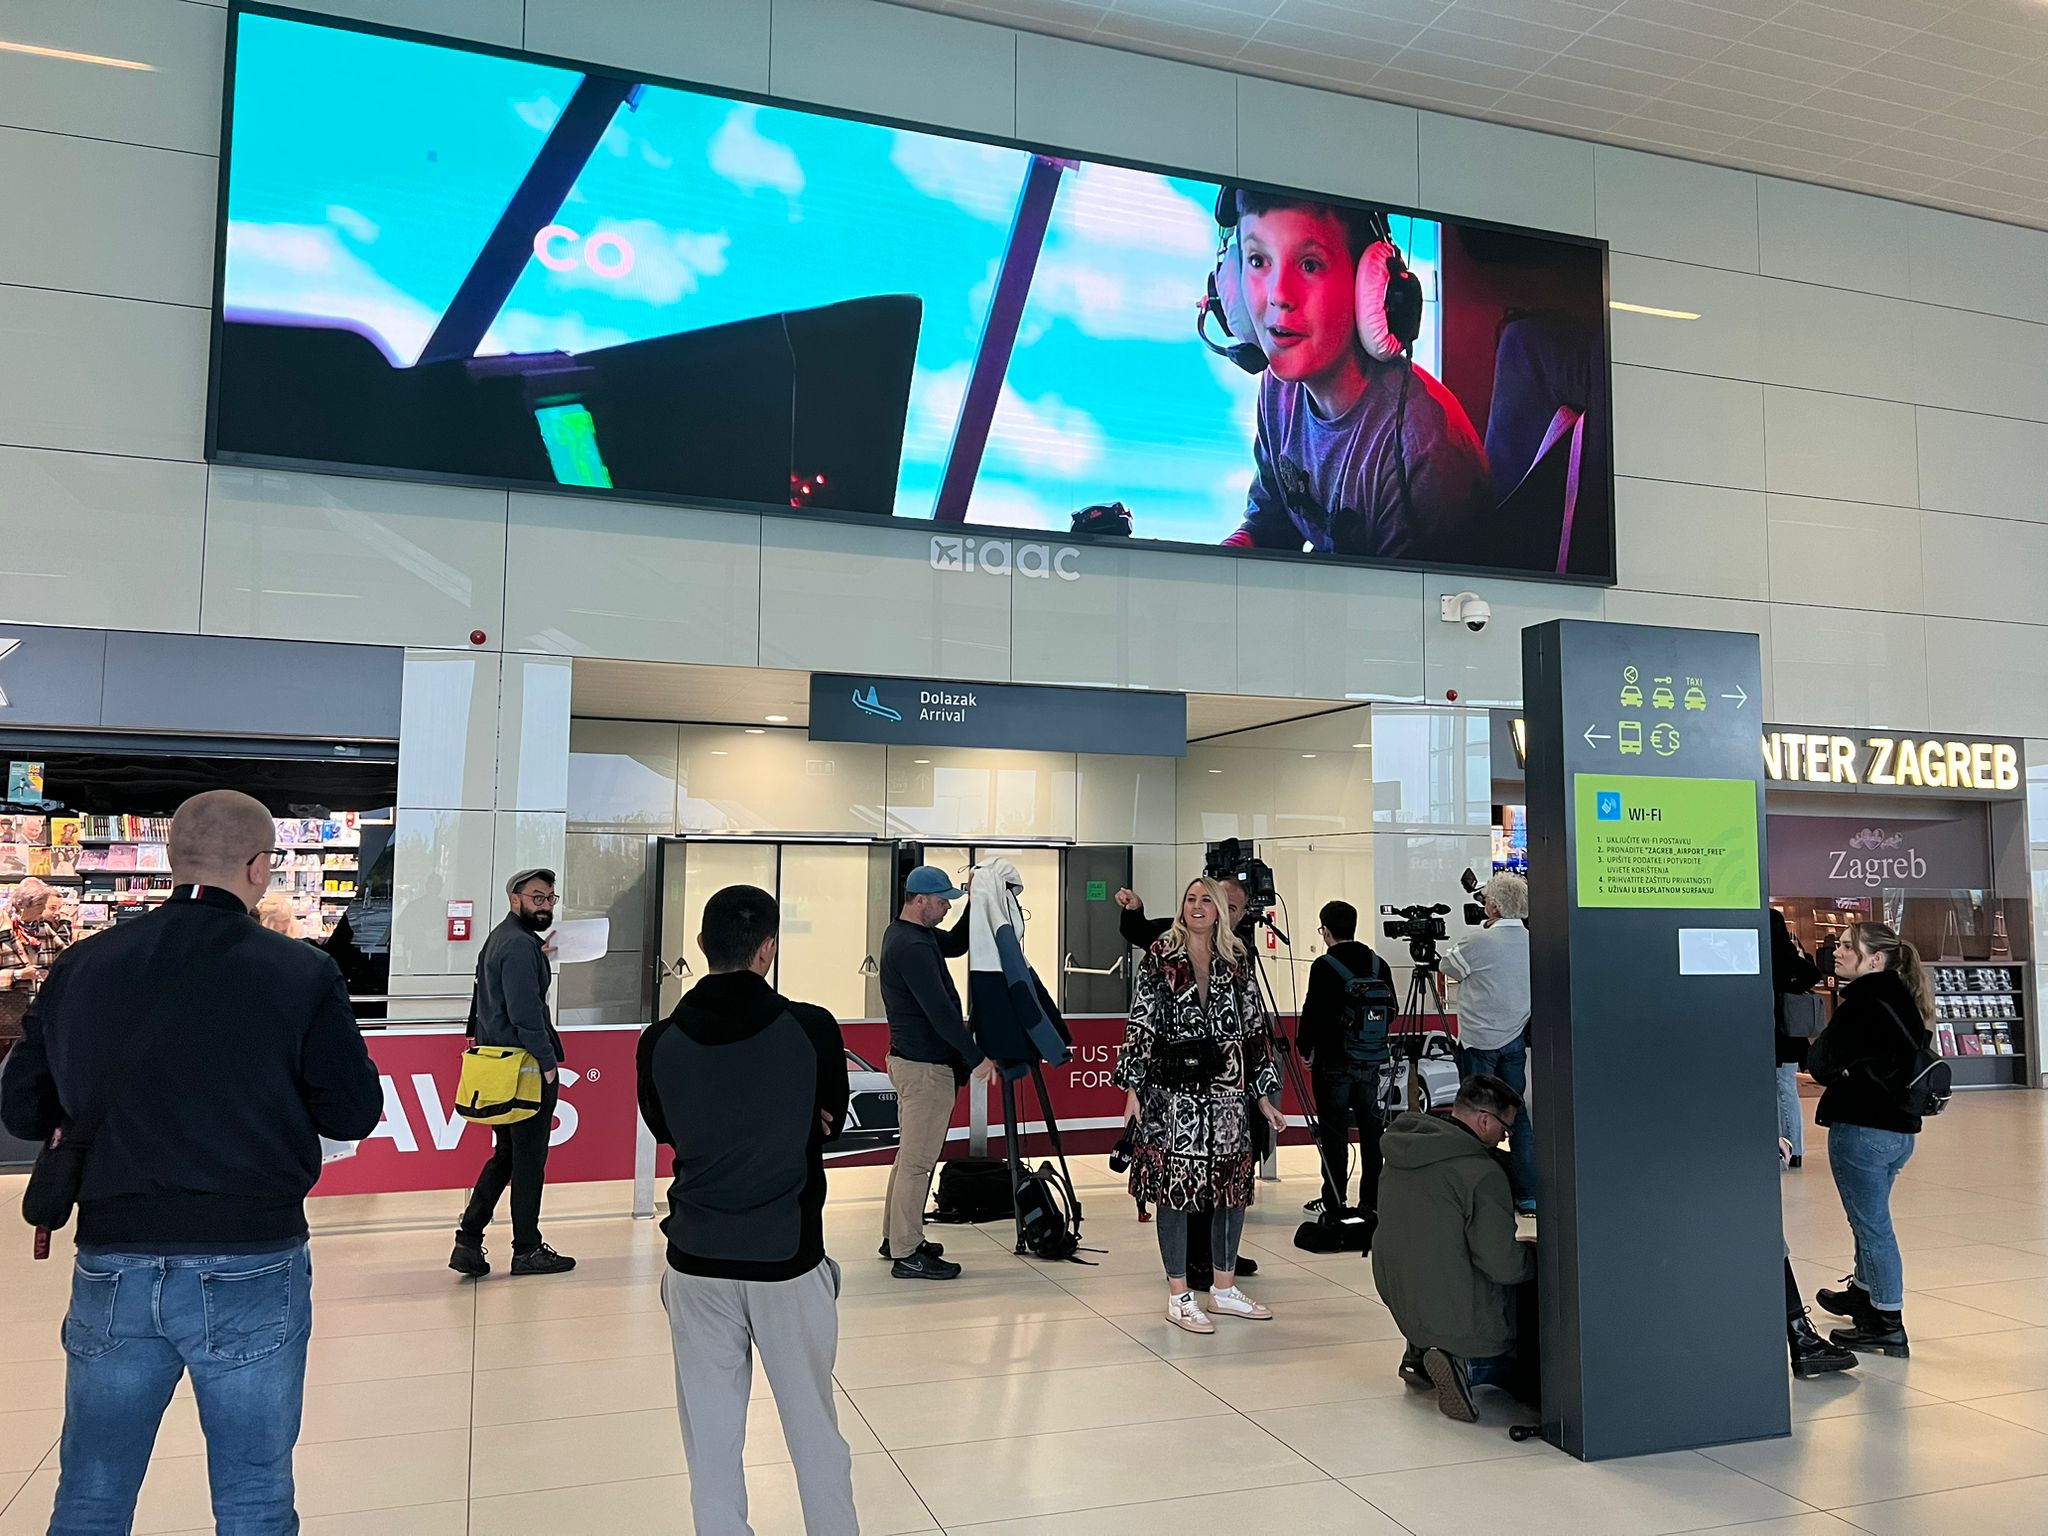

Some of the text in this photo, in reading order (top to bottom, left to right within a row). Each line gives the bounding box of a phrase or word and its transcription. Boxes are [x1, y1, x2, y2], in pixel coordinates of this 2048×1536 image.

[1685, 676, 1703, 687] TAXI
[919, 690, 977, 707] Dolazak
[919, 708, 965, 722] Arrival
[1866, 737, 2019, 791] ZAGREB
[1628, 808, 1662, 821] WI-FI
[1659, 837, 1692, 845] POSTAVKU
[1633, 856, 1662, 864] PODATKE
[1666, 857, 1702, 865] POTVRDITE
[1829, 848, 1927, 887] Zagreb
[1607, 876, 1644, 884] PRIHVATITE
[1671, 877, 1712, 885] PRIVATNOSTI
[1637, 886, 1681, 894] BESPLATNOM
[1681, 886, 1715, 895] SURFANJU
[1082, 1045, 1109, 1063] US
[1070, 1070, 1112, 1089] FOR
